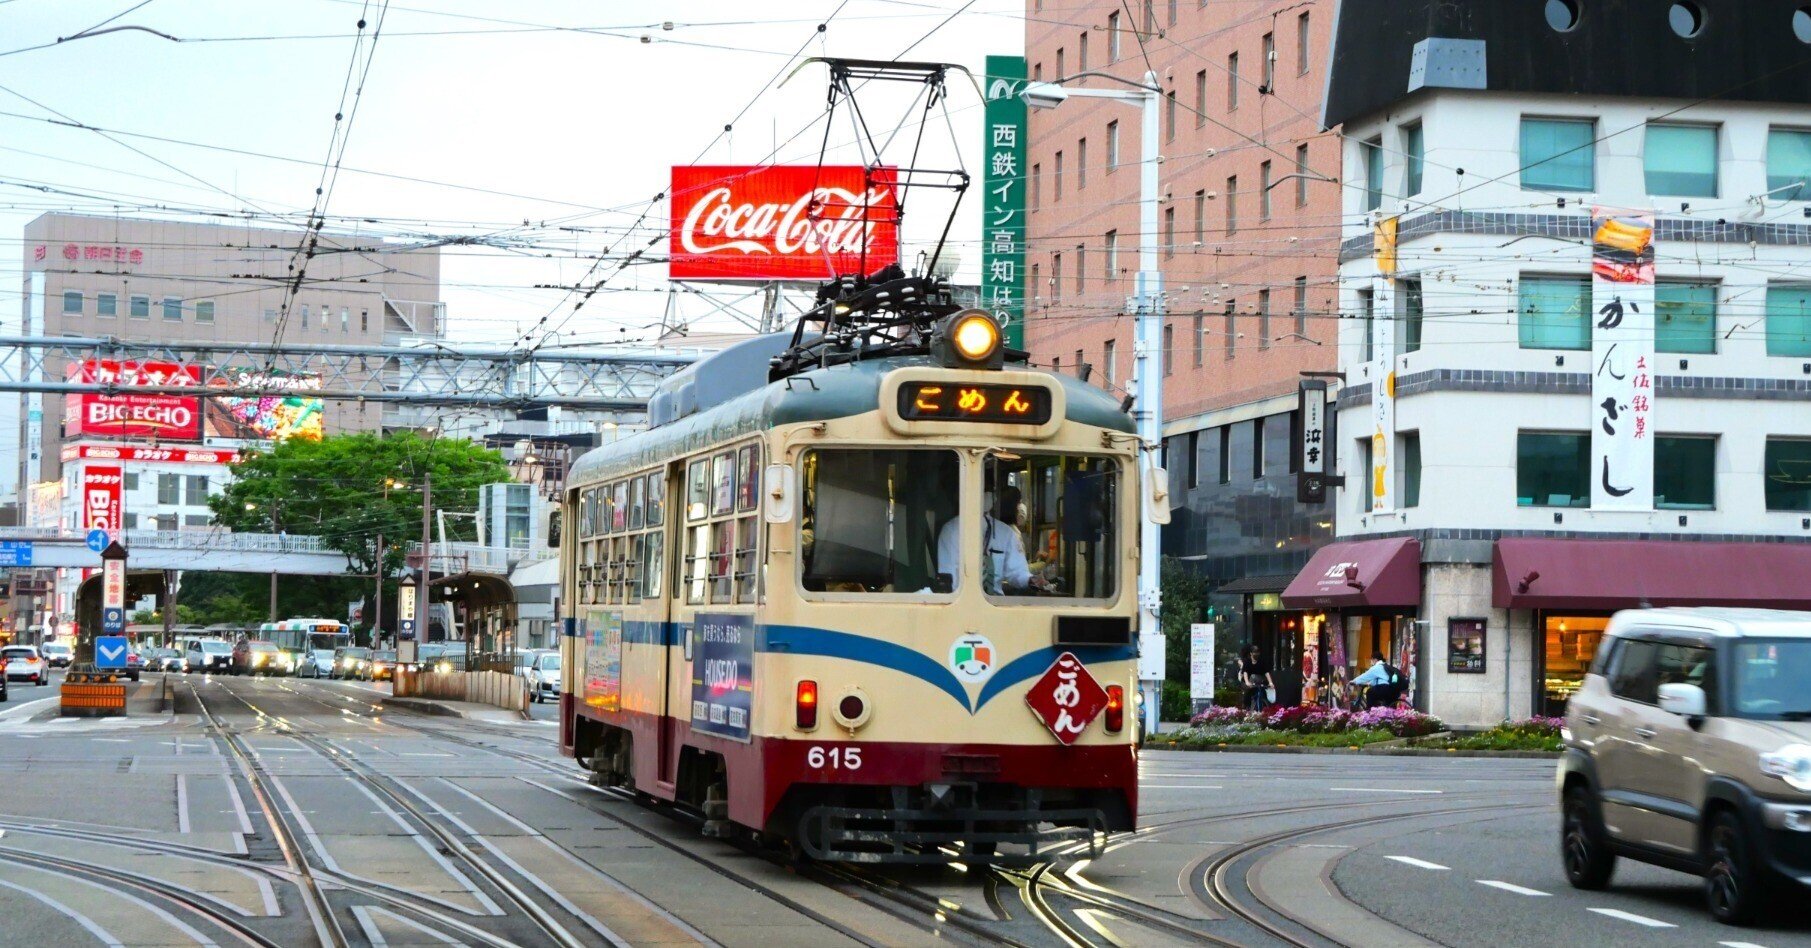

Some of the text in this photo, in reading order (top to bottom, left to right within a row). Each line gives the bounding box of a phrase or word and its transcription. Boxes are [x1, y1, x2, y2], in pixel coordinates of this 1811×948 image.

[681, 187, 890, 255] Coca-Cola
[89, 402, 129, 423] BIG
[133, 406, 192, 427] ECHO
[1597, 295, 1640, 498] かんざし
[1631, 355, 1650, 439] 土佐銘菓
[1052, 659, 1086, 734] ごめん
[807, 746, 862, 770] 615
